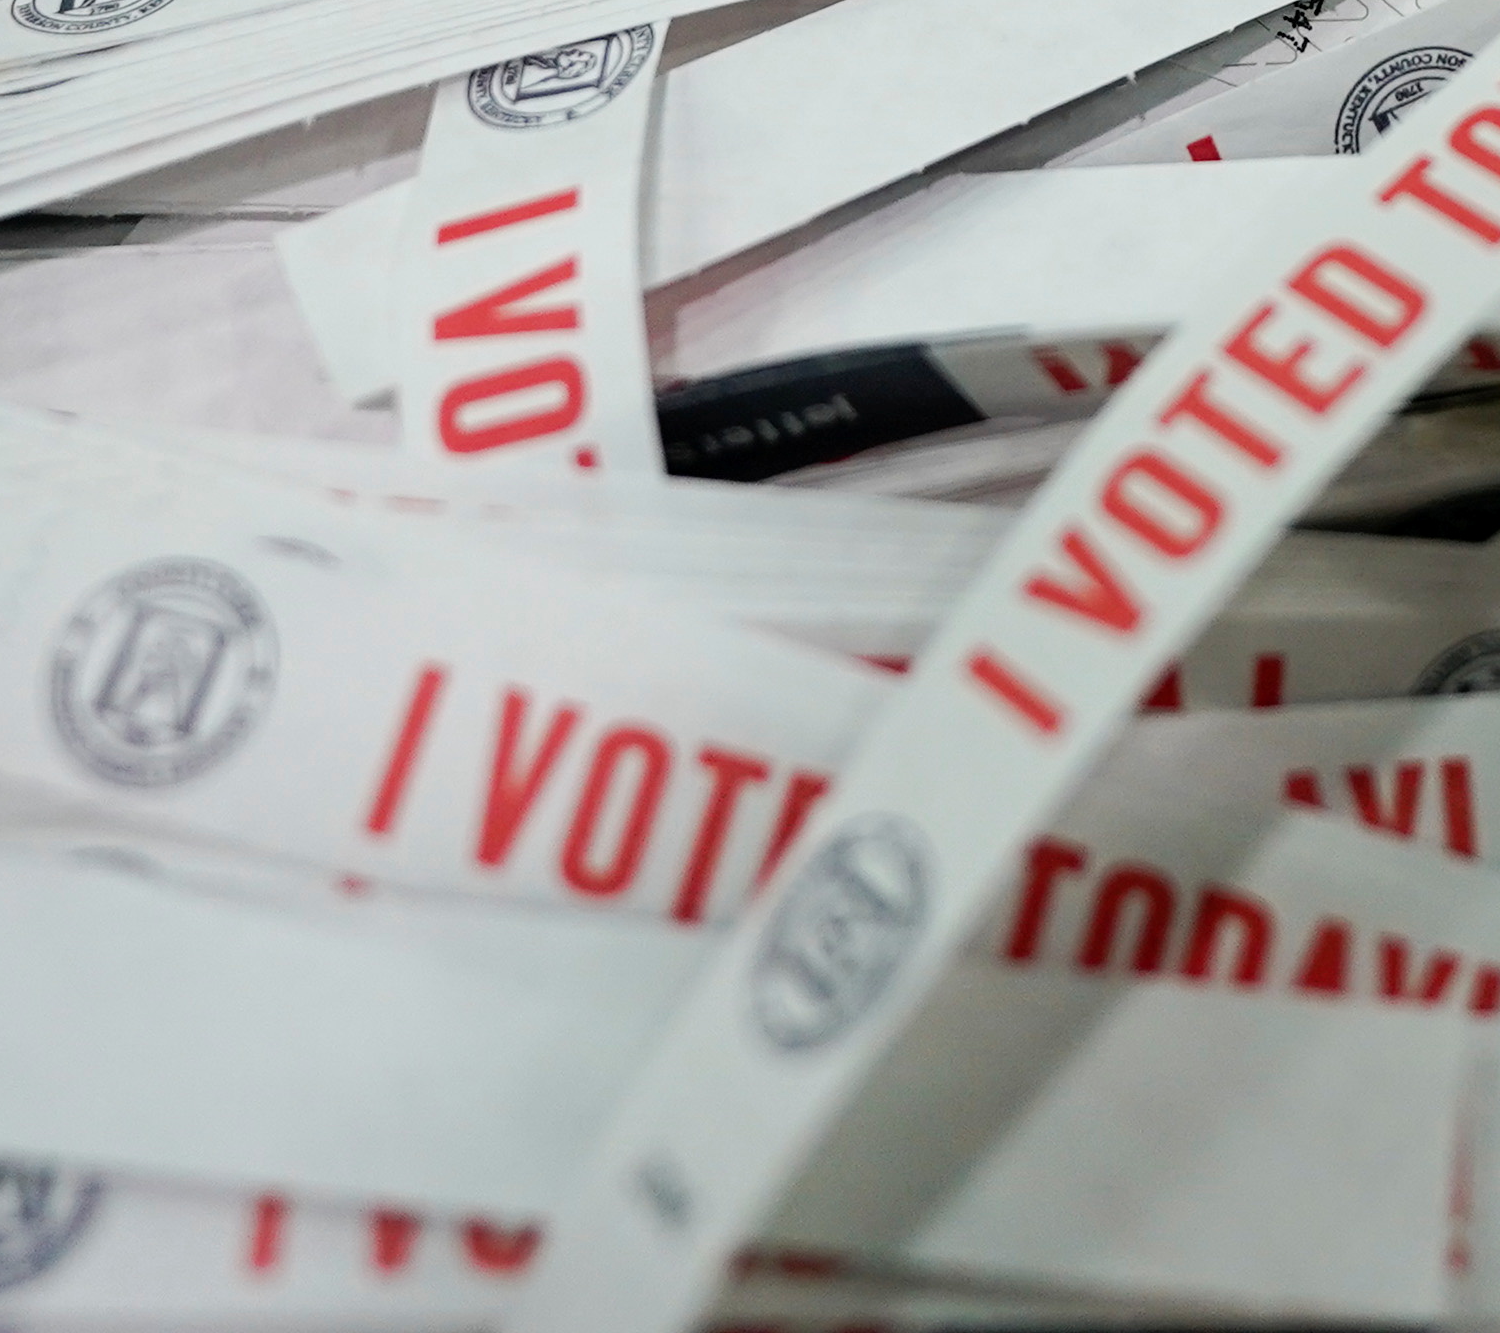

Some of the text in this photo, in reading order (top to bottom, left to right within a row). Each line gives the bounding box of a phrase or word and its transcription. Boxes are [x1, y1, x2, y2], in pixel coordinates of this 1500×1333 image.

[1340, 85, 1372, 154] KENTUCK
[436, 185, 581, 245] I
[969, 651, 1065, 733] I
[1023, 243, 1428, 638] VOTED
[365, 662, 445, 835] I
[476, 686, 832, 927] VOT
